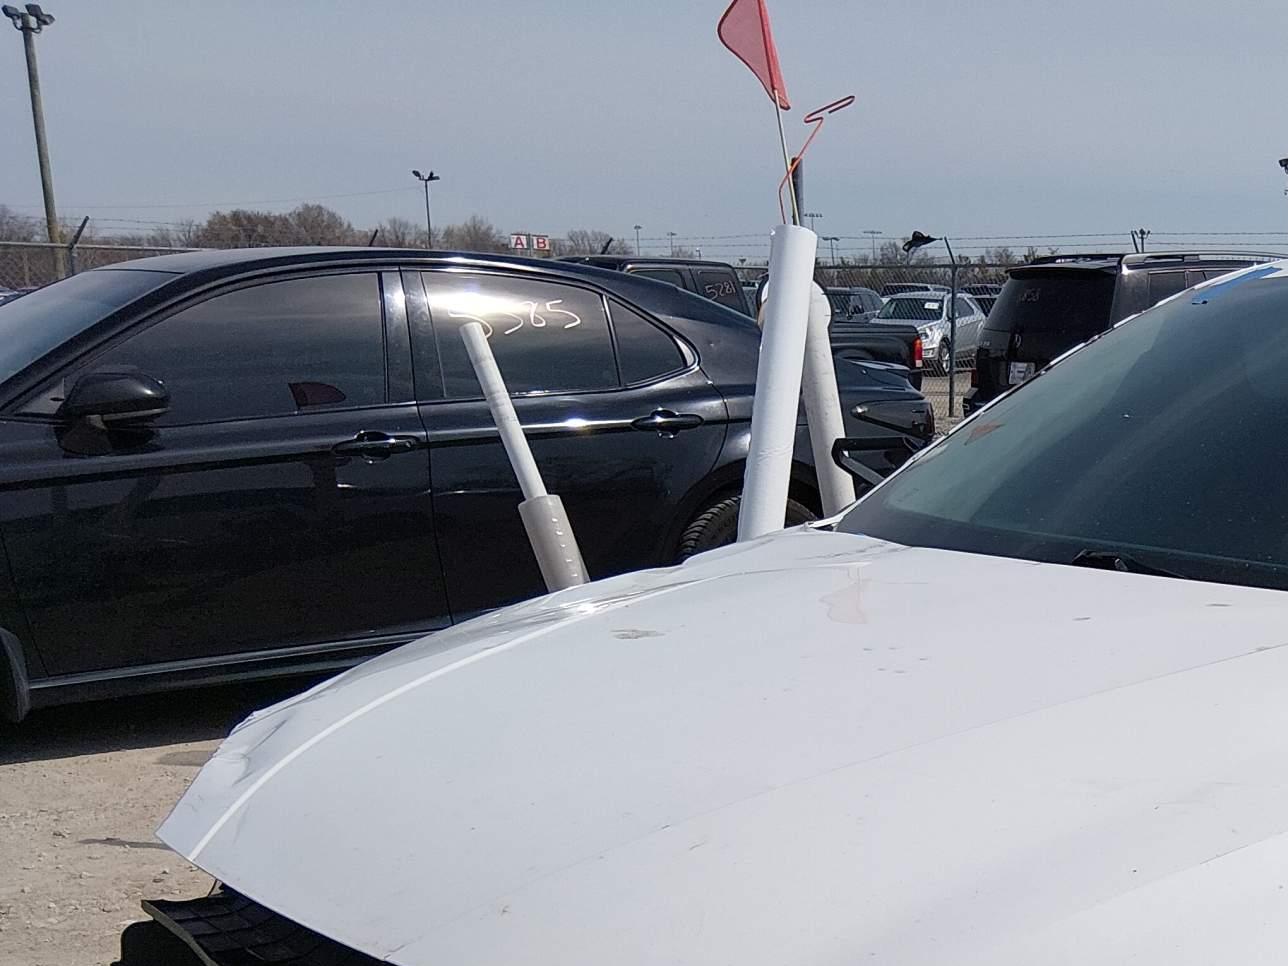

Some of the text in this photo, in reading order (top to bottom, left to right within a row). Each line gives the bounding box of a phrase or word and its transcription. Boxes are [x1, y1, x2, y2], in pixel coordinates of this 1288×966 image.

[513, 236, 526, 249] A
[536, 237, 548, 249] B
[704, 280, 737, 301] 5281
